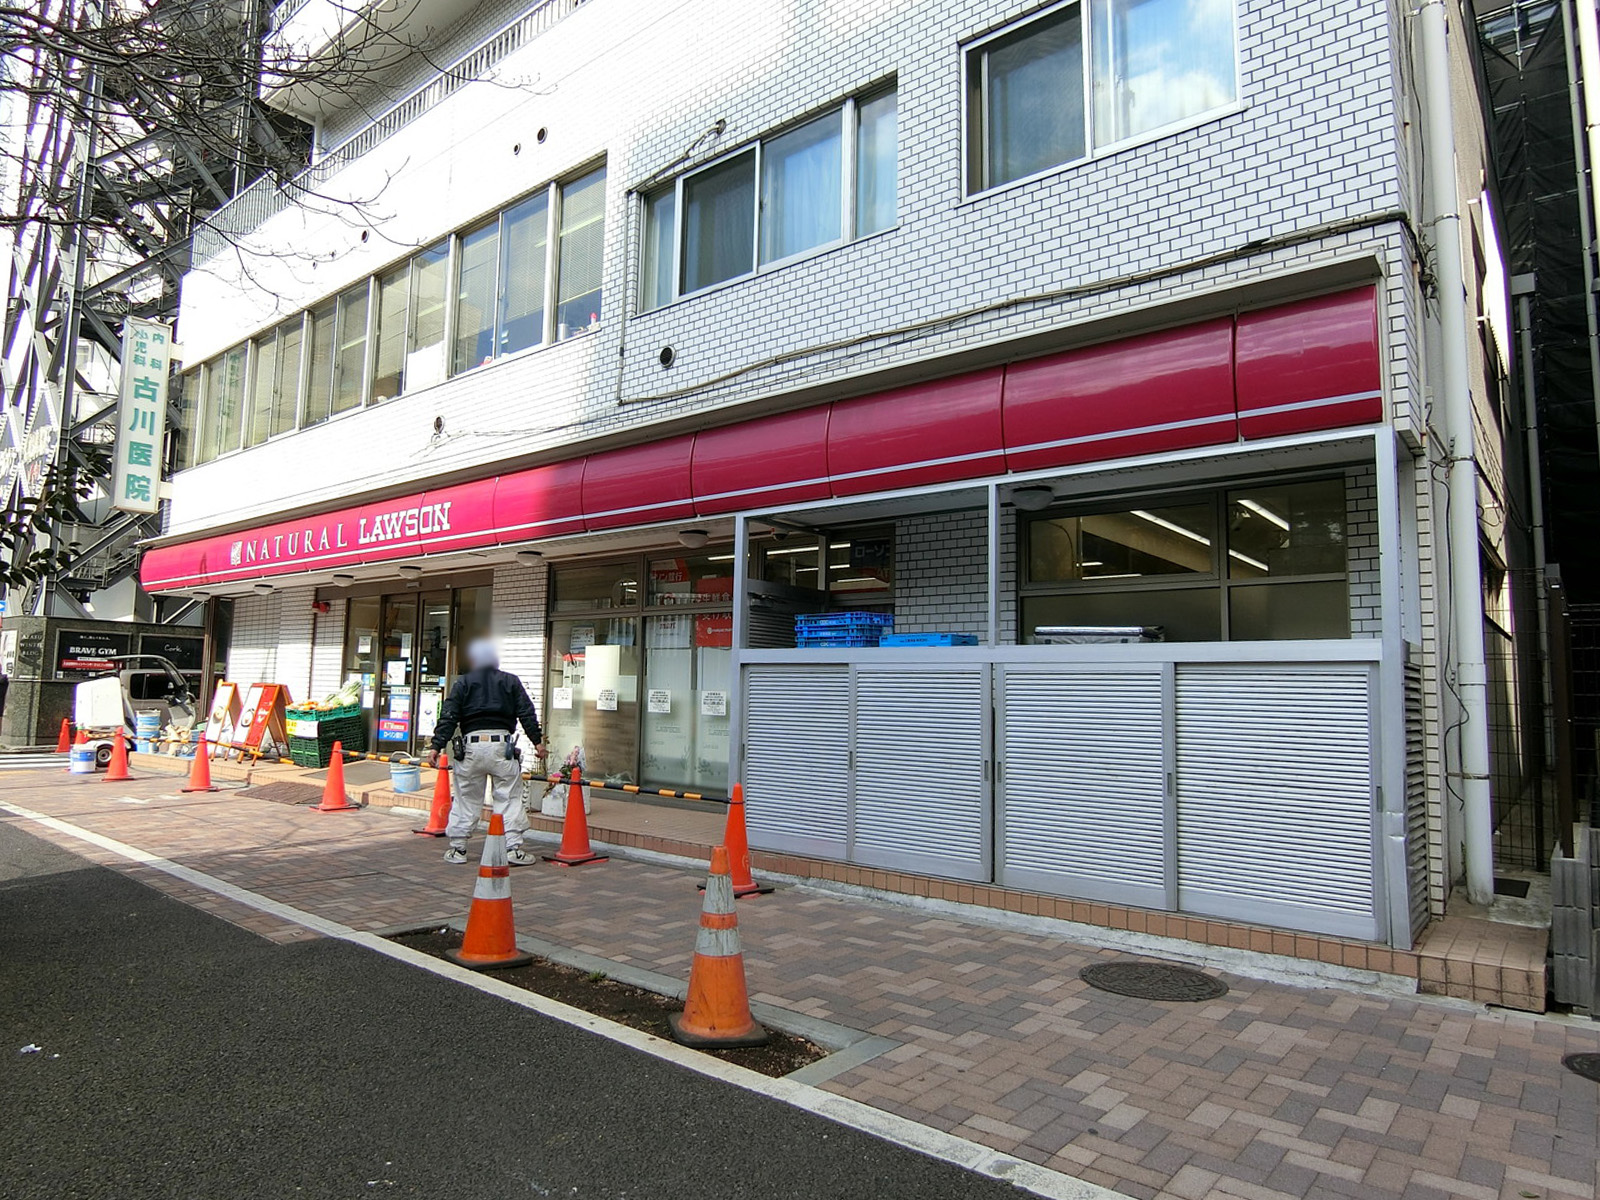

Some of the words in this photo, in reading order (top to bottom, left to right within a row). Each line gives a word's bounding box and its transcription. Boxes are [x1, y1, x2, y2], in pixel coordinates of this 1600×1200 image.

[133, 329, 149, 367] 小児科
[149, 332, 165, 371] 内科
[124, 376, 160, 502] 古川医院
[246, 522, 348, 564] NATURAL
[358, 501, 452, 545] LAWSON
[69, 646, 97, 656] BRAVE
[98, 647, 117, 655] GYM
